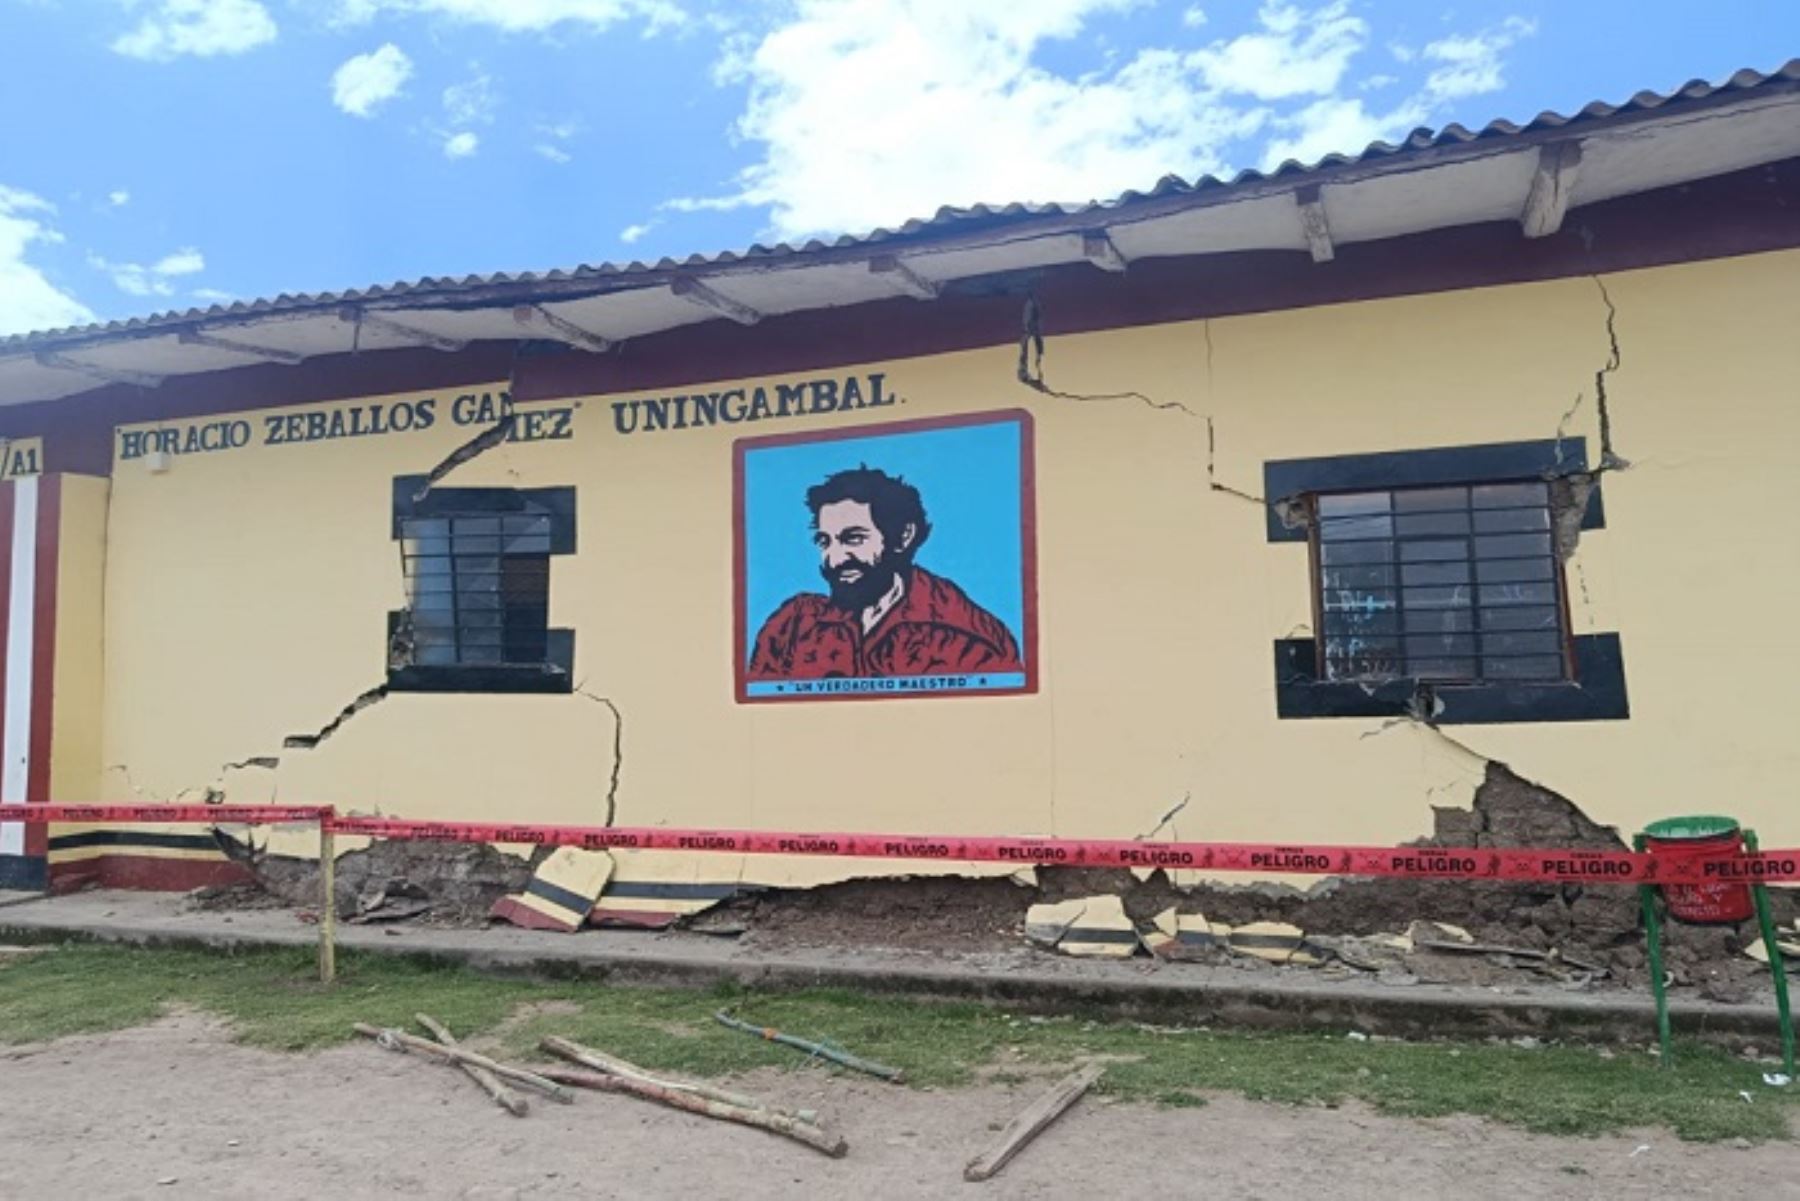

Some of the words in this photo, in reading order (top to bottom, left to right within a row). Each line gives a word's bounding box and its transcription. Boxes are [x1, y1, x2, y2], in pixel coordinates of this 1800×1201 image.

[264, 400, 435, 446] ZEBALLOS
[818, 679, 894, 692] VERDADERO
[585, 834, 638, 847] PELIGRO
[679, 837, 736, 850] PELIGRO
[779, 840, 838, 853] PELIGRO
[885, 842, 949, 857] PELIGRO
[999, 846, 1067, 861] PELIGRO
[1119, 849, 1194, 865] PELIGRO
[1251, 852, 1330, 869] PELIGRO
[1392, 857, 1476, 874] PELIGRO
[1542, 859, 1633, 876] PELIGRO
[1703, 859, 1795, 877] PELIGRO
